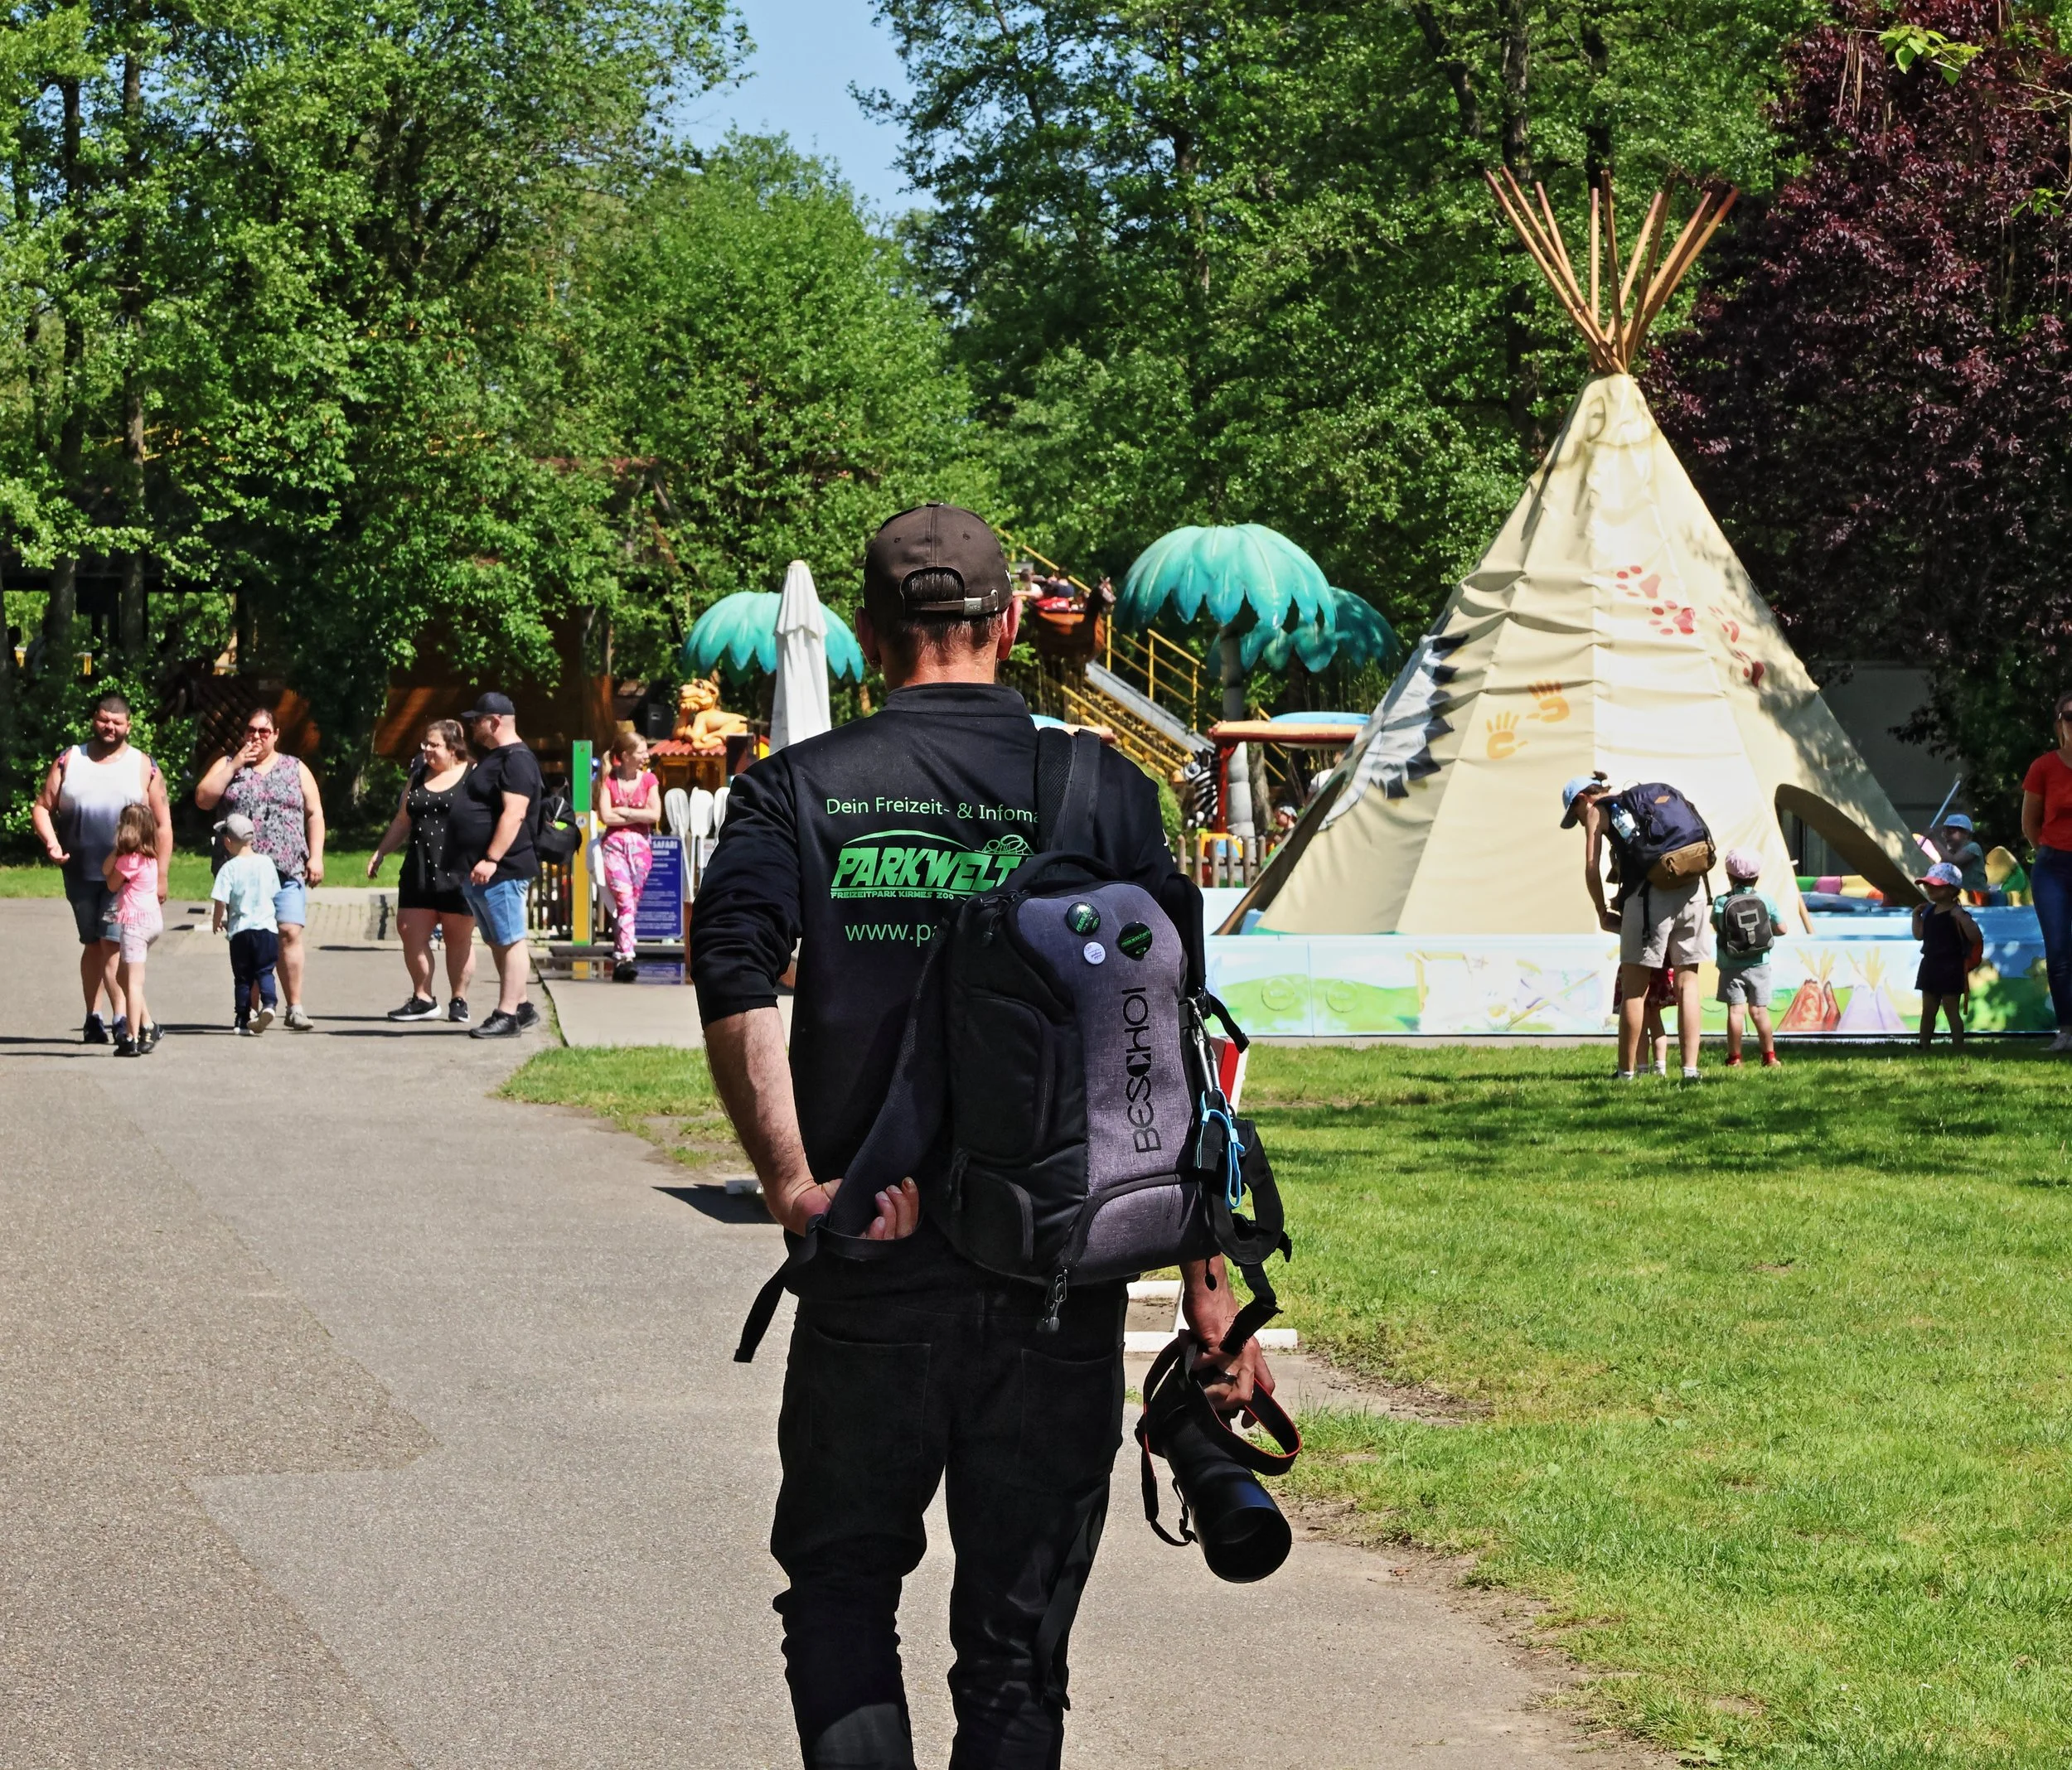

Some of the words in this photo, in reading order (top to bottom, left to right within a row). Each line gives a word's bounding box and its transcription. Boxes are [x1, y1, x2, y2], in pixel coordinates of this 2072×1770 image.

[826, 797, 869, 815] Dein
[875, 796, 950, 815] Freizeit-
[956, 802, 973, 820] &
[652, 839, 678, 849] SAFARI
[830, 847, 1031, 892] PARKWELT
[830, 891, 897, 899] FREIZEITPARK
[898, 891, 933, 899] KIRMES
[937, 892, 955, 901] ZOO
